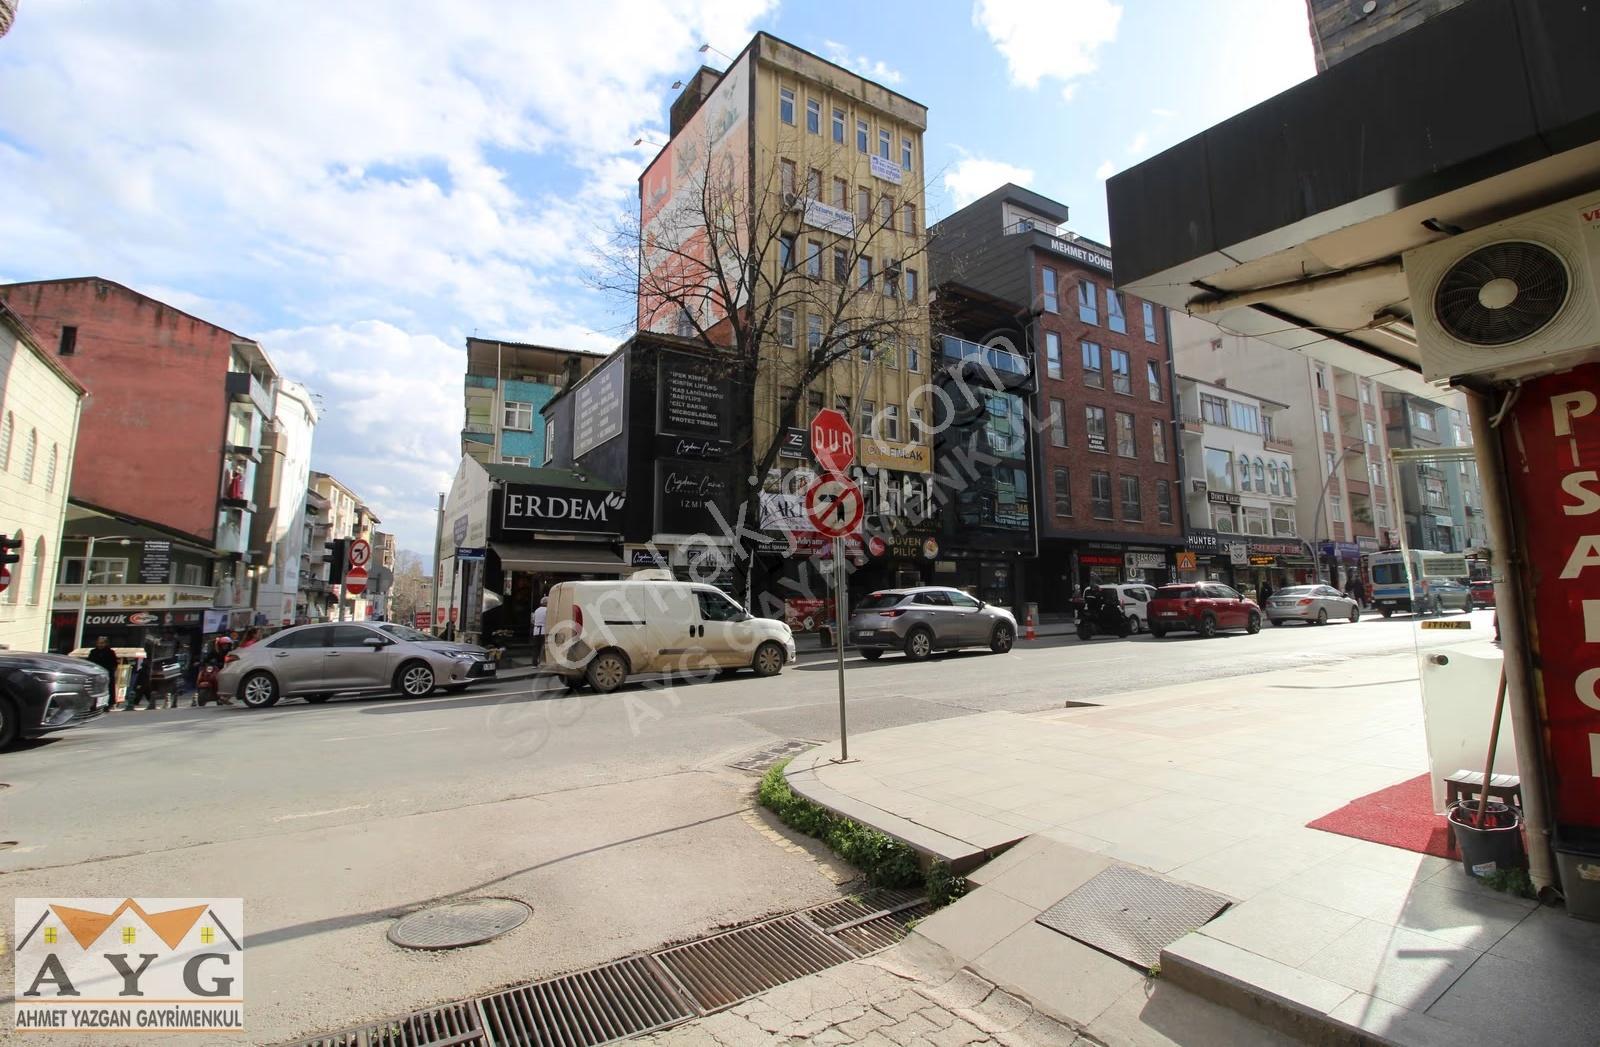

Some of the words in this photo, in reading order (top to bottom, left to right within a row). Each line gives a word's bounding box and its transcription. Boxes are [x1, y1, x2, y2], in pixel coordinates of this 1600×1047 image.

[1051, 239, 1087, 261] MEHMET
[1088, 252, 1113, 270] DÖNE
[815, 425, 852, 456] DUR
[890, 447, 923, 461] EMLAK
[507, 494, 609, 522] ERDEM
[1188, 536, 1217, 546] HUNTER
[85, 613, 127, 626] tavuk
